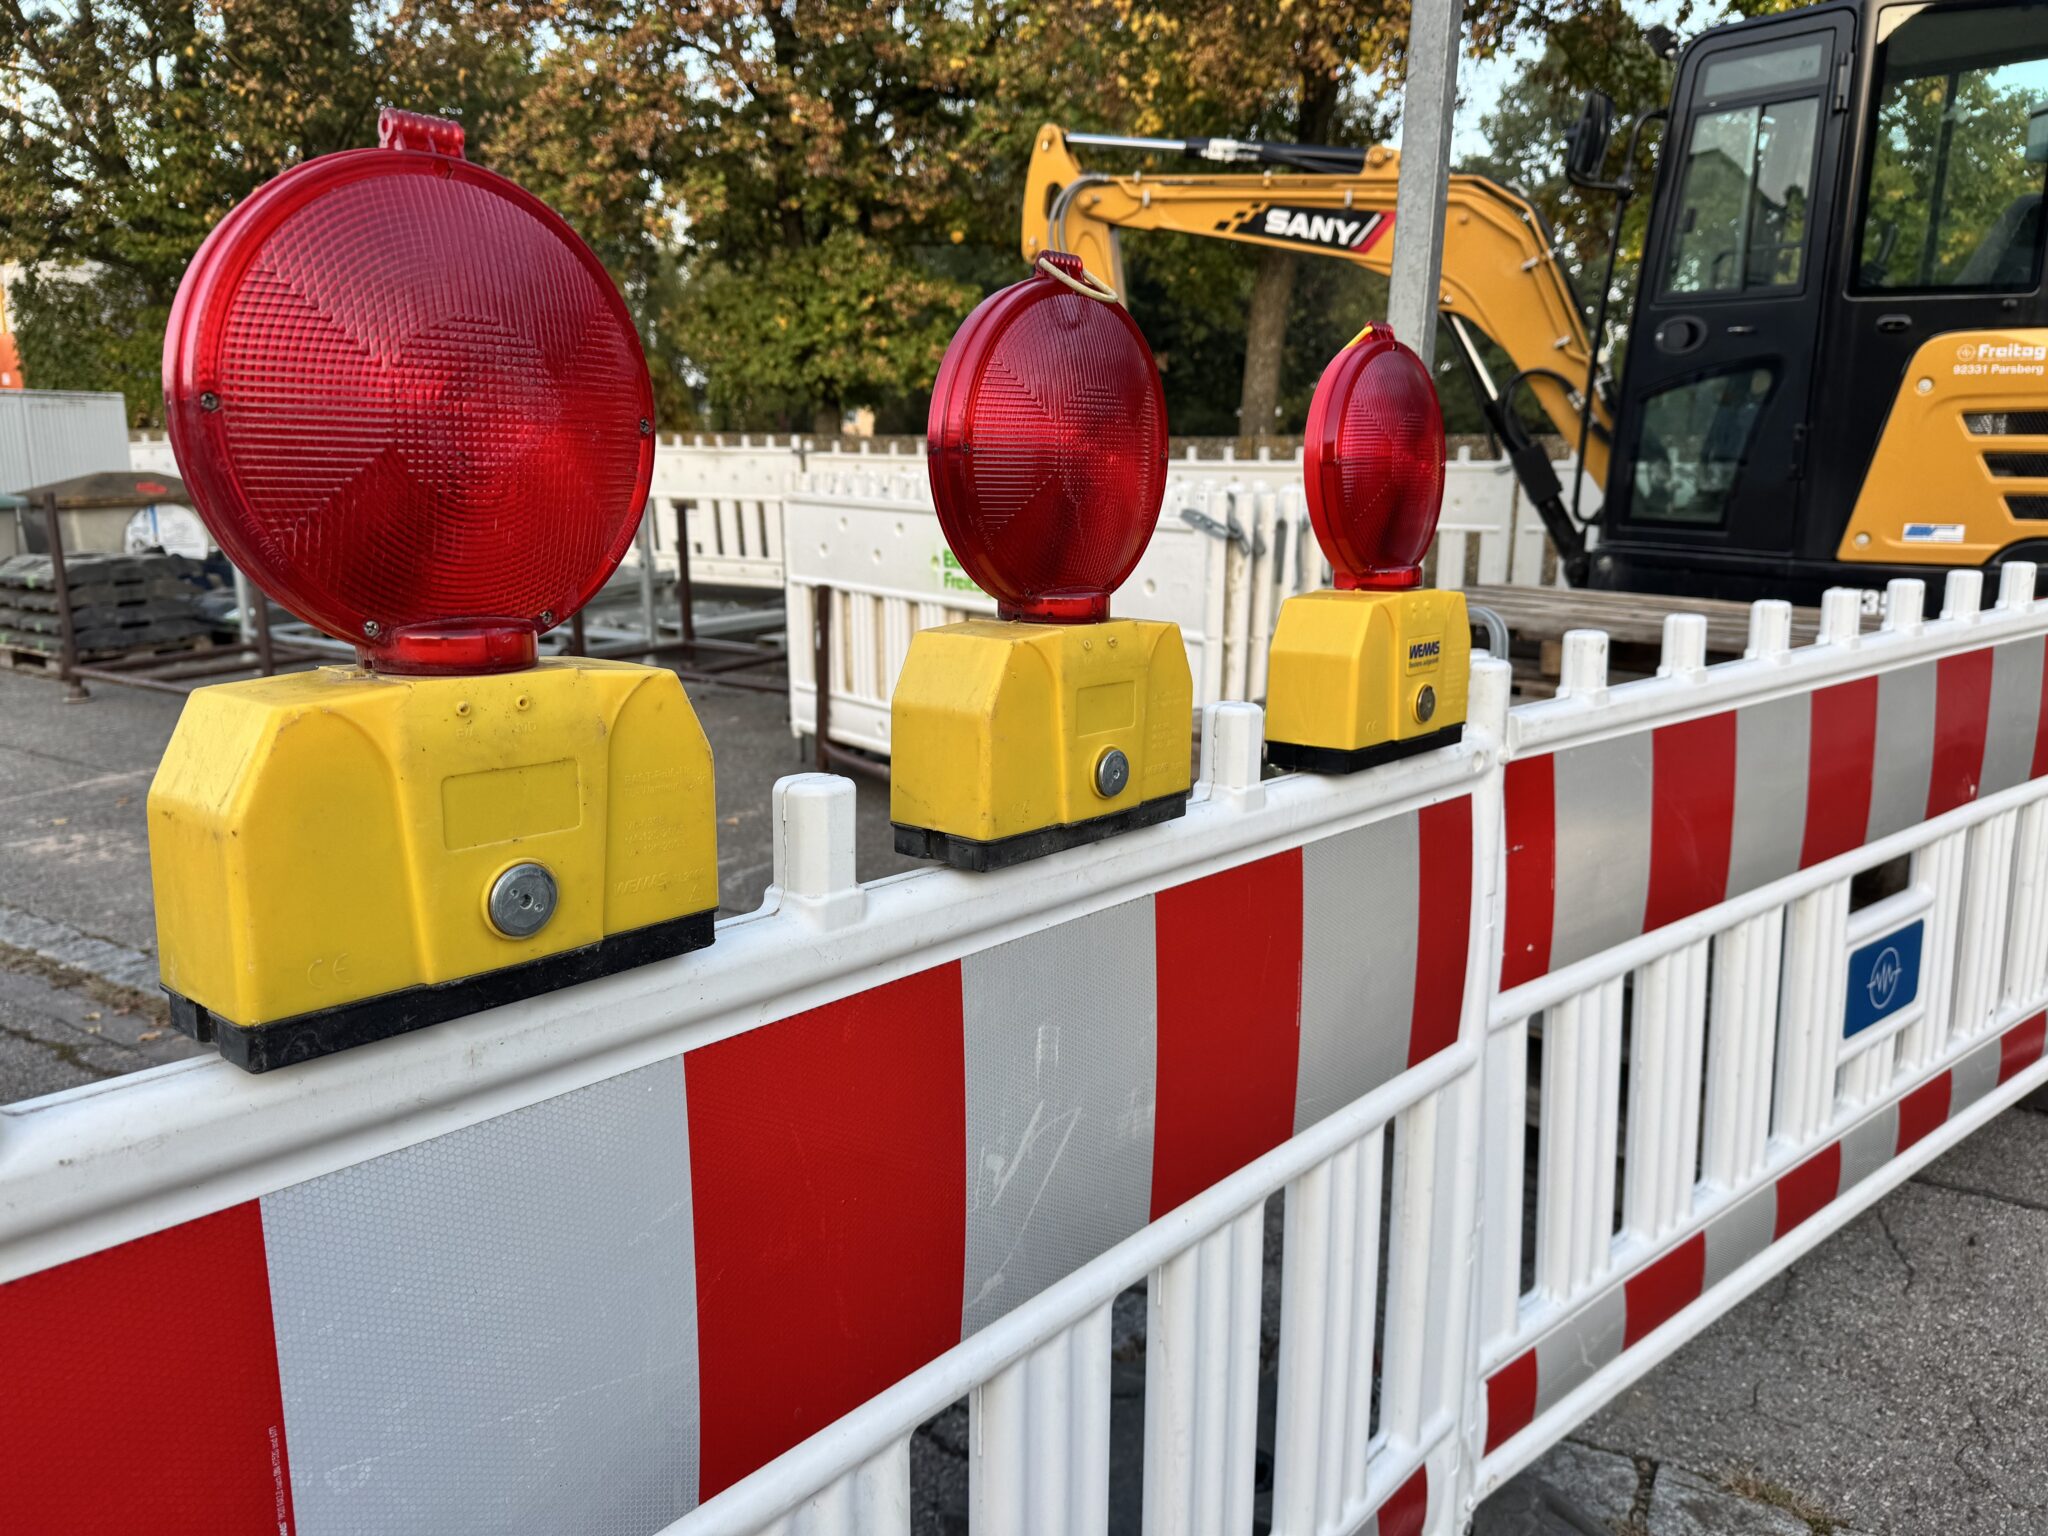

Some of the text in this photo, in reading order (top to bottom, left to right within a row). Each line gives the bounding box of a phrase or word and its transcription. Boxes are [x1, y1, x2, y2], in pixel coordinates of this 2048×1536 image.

[1264, 208, 1359, 245] SANY
[1978, 343, 2047, 361] Freitag
[1991, 363, 2045, 376] Parsberg
